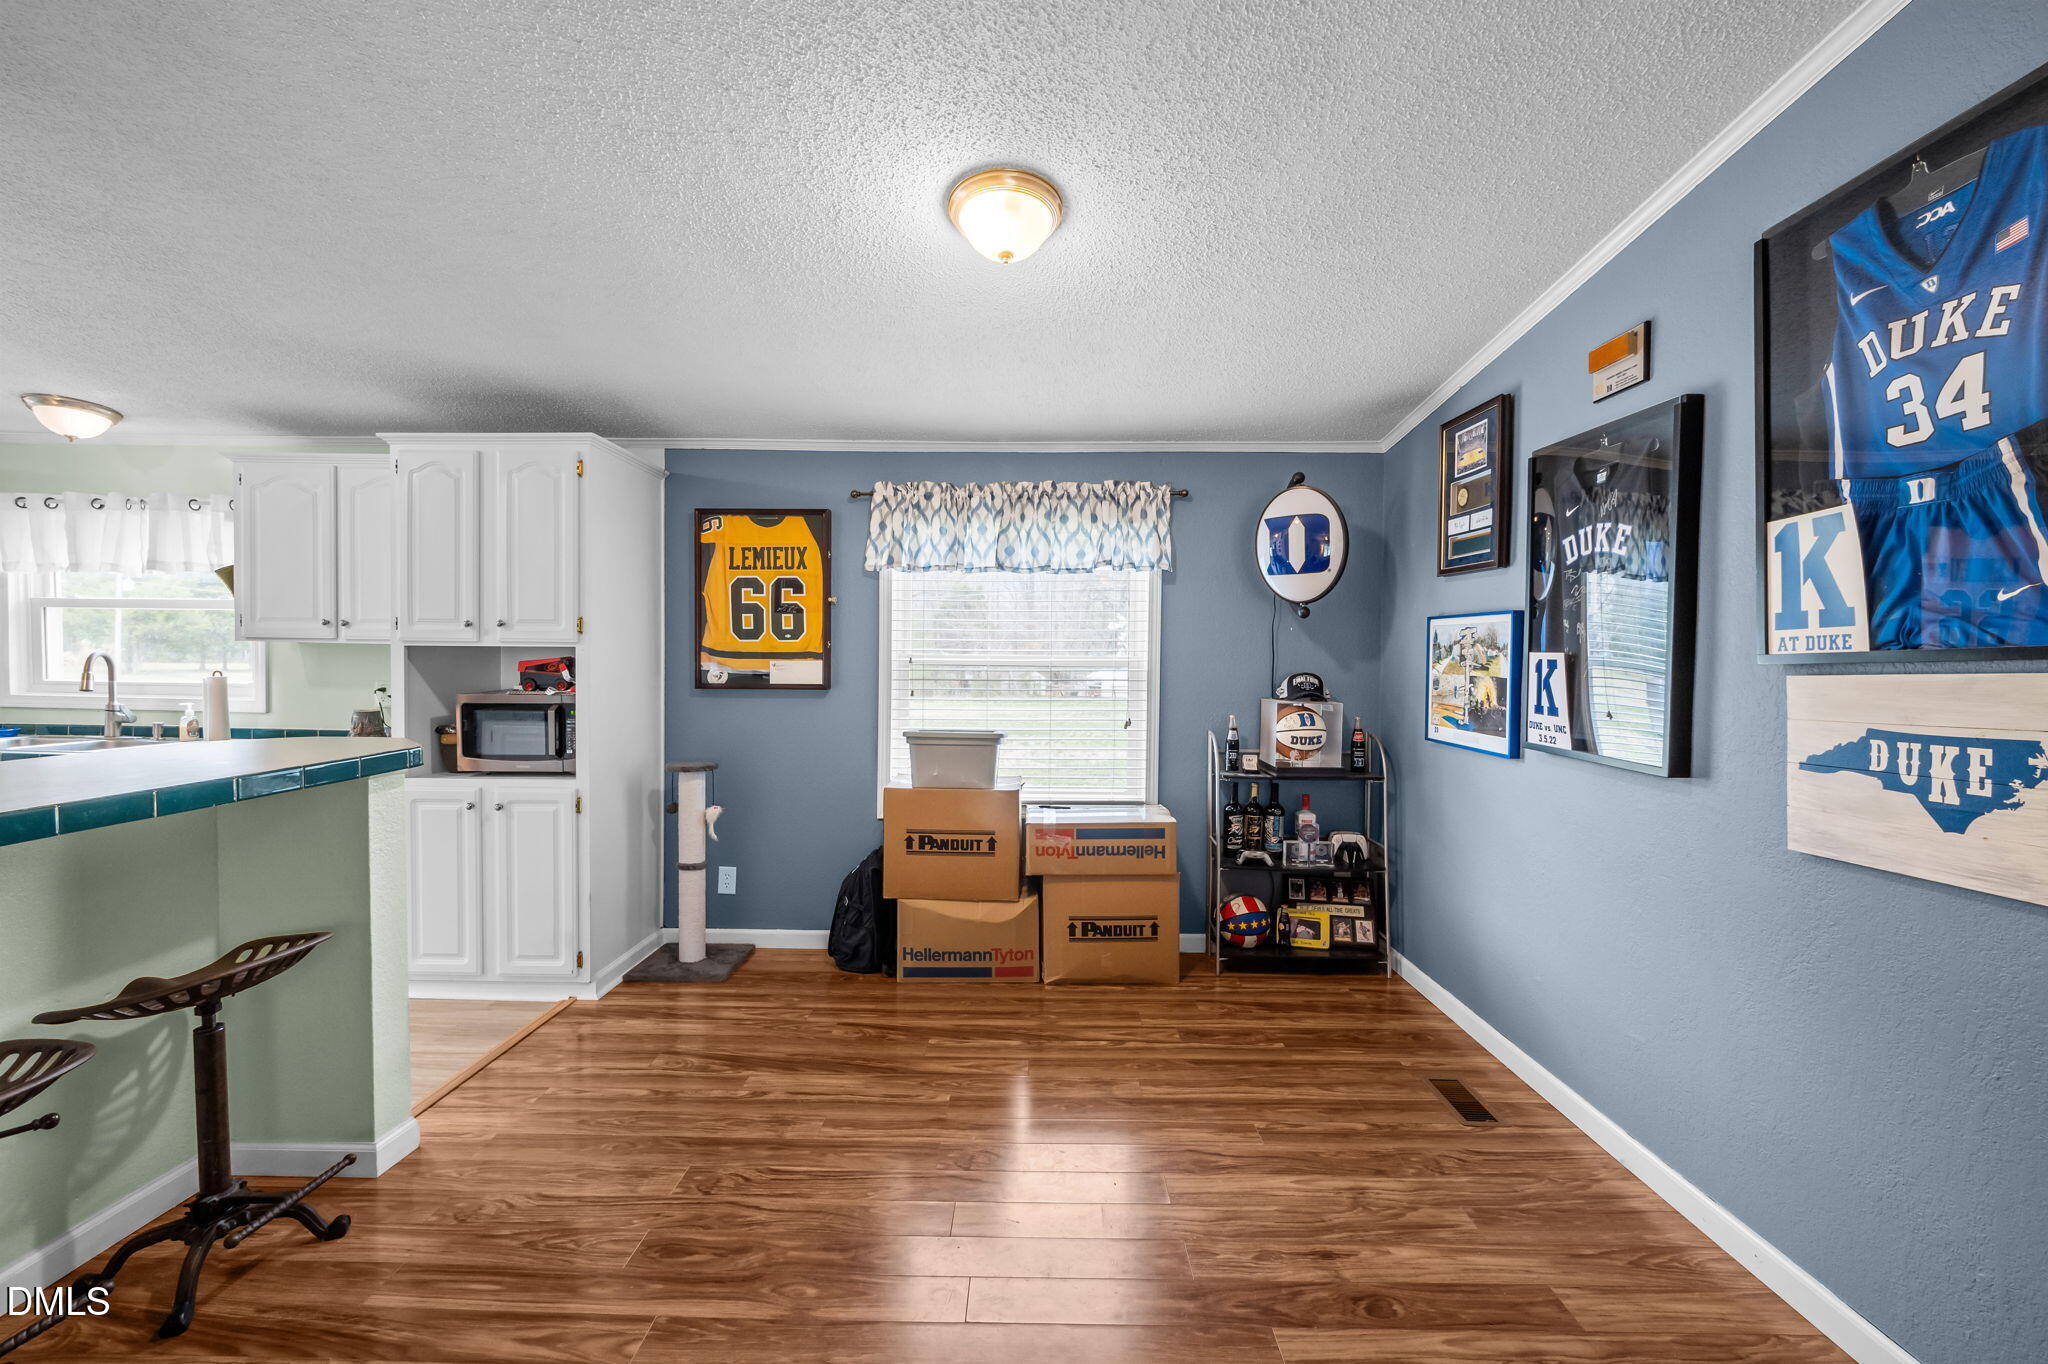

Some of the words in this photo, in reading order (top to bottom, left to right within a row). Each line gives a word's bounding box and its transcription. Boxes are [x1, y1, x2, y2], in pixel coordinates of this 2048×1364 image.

[1857, 283, 2022, 379] DUKE
[1886, 351, 1992, 448] 34
[1562, 522, 1632, 566] DUKE
[728, 546, 808, 571] LEMIEUX
[729, 575, 807, 642] 66
[1778, 637, 1799, 652] AT
[1805, 633, 1853, 650] DUKE
[1529, 720, 1543, 731] DUKE
[1553, 724, 1567, 734] UNC
[1290, 736, 1322, 746] DUKE
[1869, 739, 1993, 805] DUKE
[918, 835, 983, 851] PANDUIT
[1035, 843, 1166, 859] HellermannTyton
[1081, 922, 1146, 937] PANDUIT
[902, 946, 1034, 965] HellermannTyton
